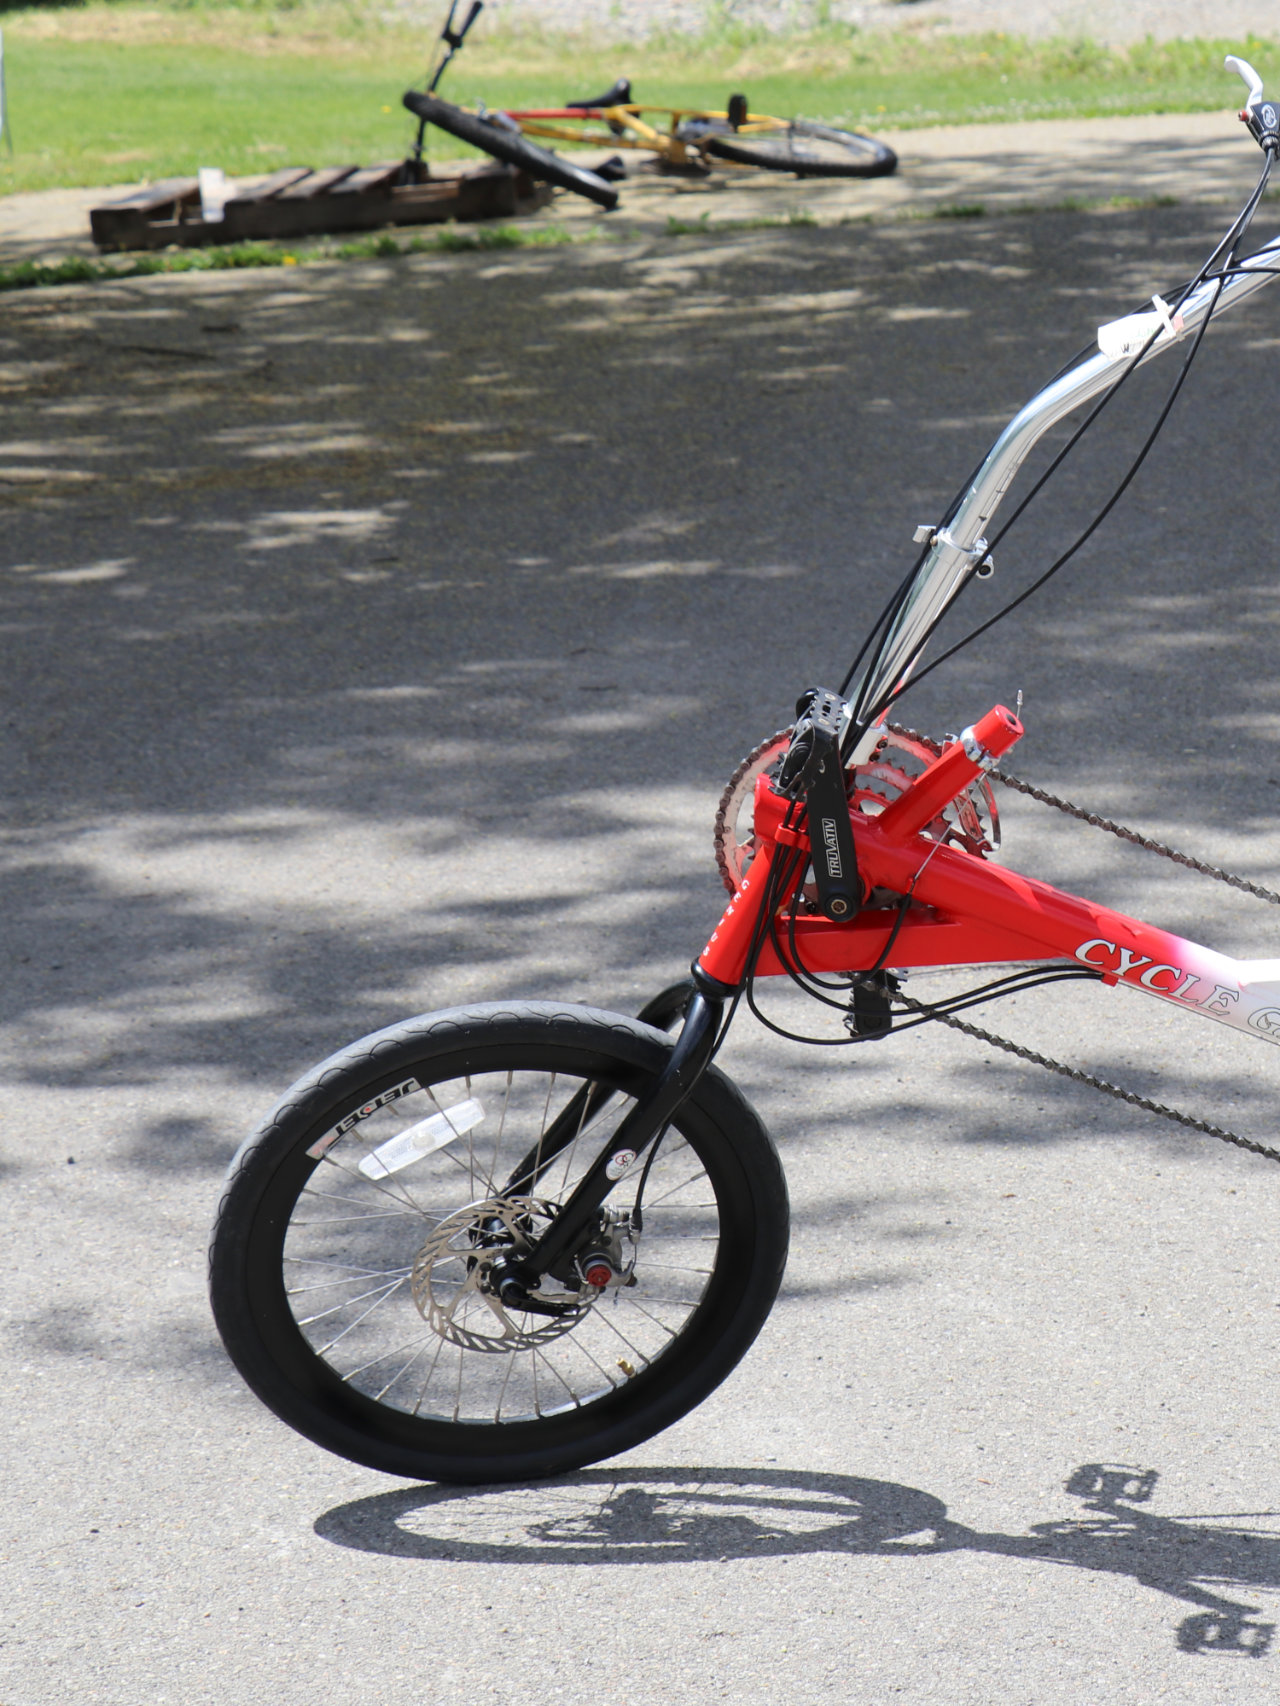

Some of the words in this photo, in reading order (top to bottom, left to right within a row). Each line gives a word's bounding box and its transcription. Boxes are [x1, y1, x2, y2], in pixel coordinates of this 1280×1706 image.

[823, 819, 841, 877] TRUVATIV
[703, 880, 750, 956] GENIUS
[1075, 939, 1239, 1015] CYCLE
